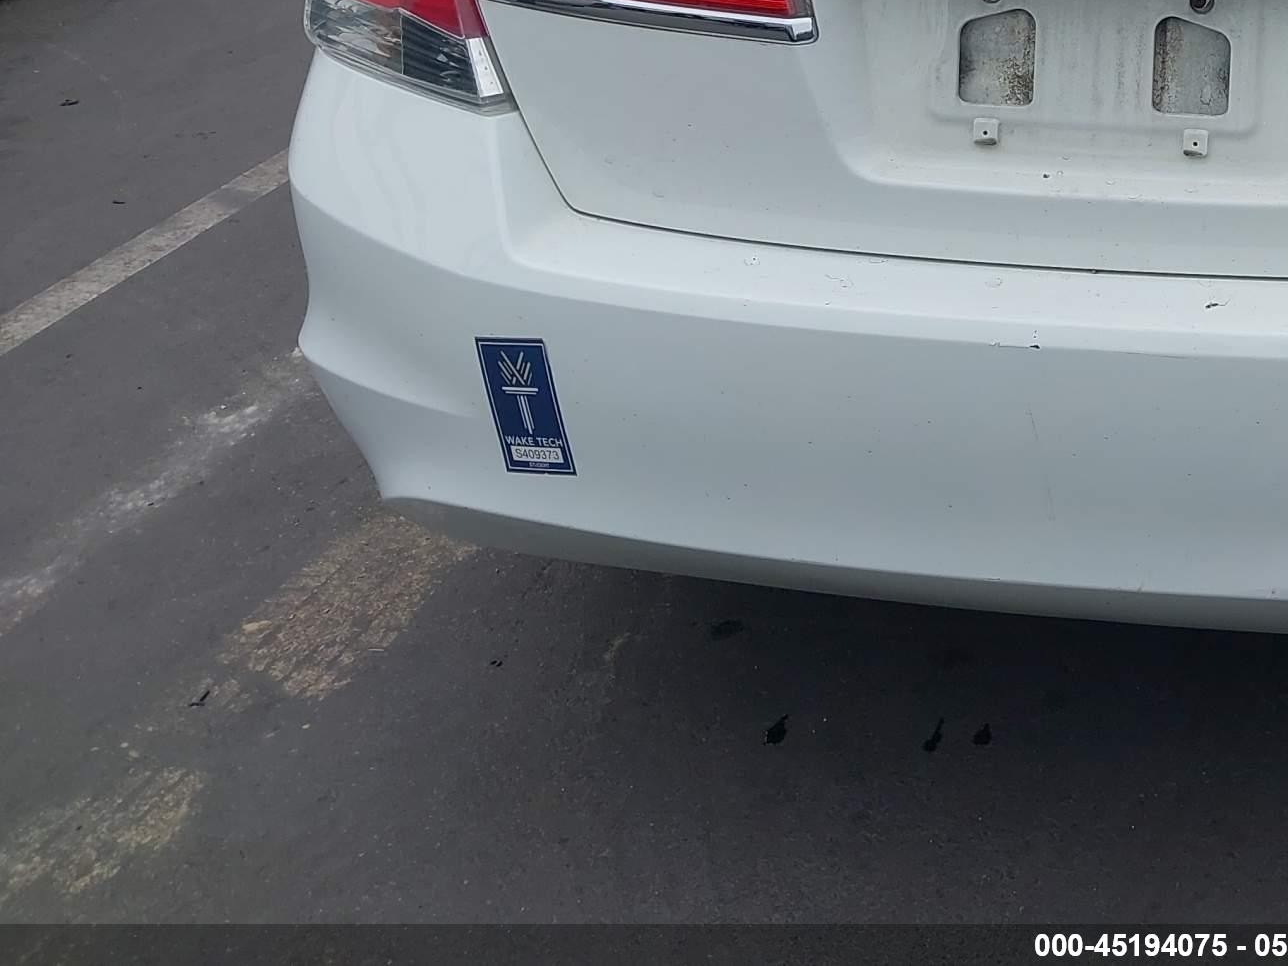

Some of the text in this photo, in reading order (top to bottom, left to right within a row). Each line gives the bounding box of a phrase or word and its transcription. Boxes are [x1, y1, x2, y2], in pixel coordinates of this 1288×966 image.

[504, 435, 563, 447] WAKE TECH
[515, 448, 560, 460] S409373
